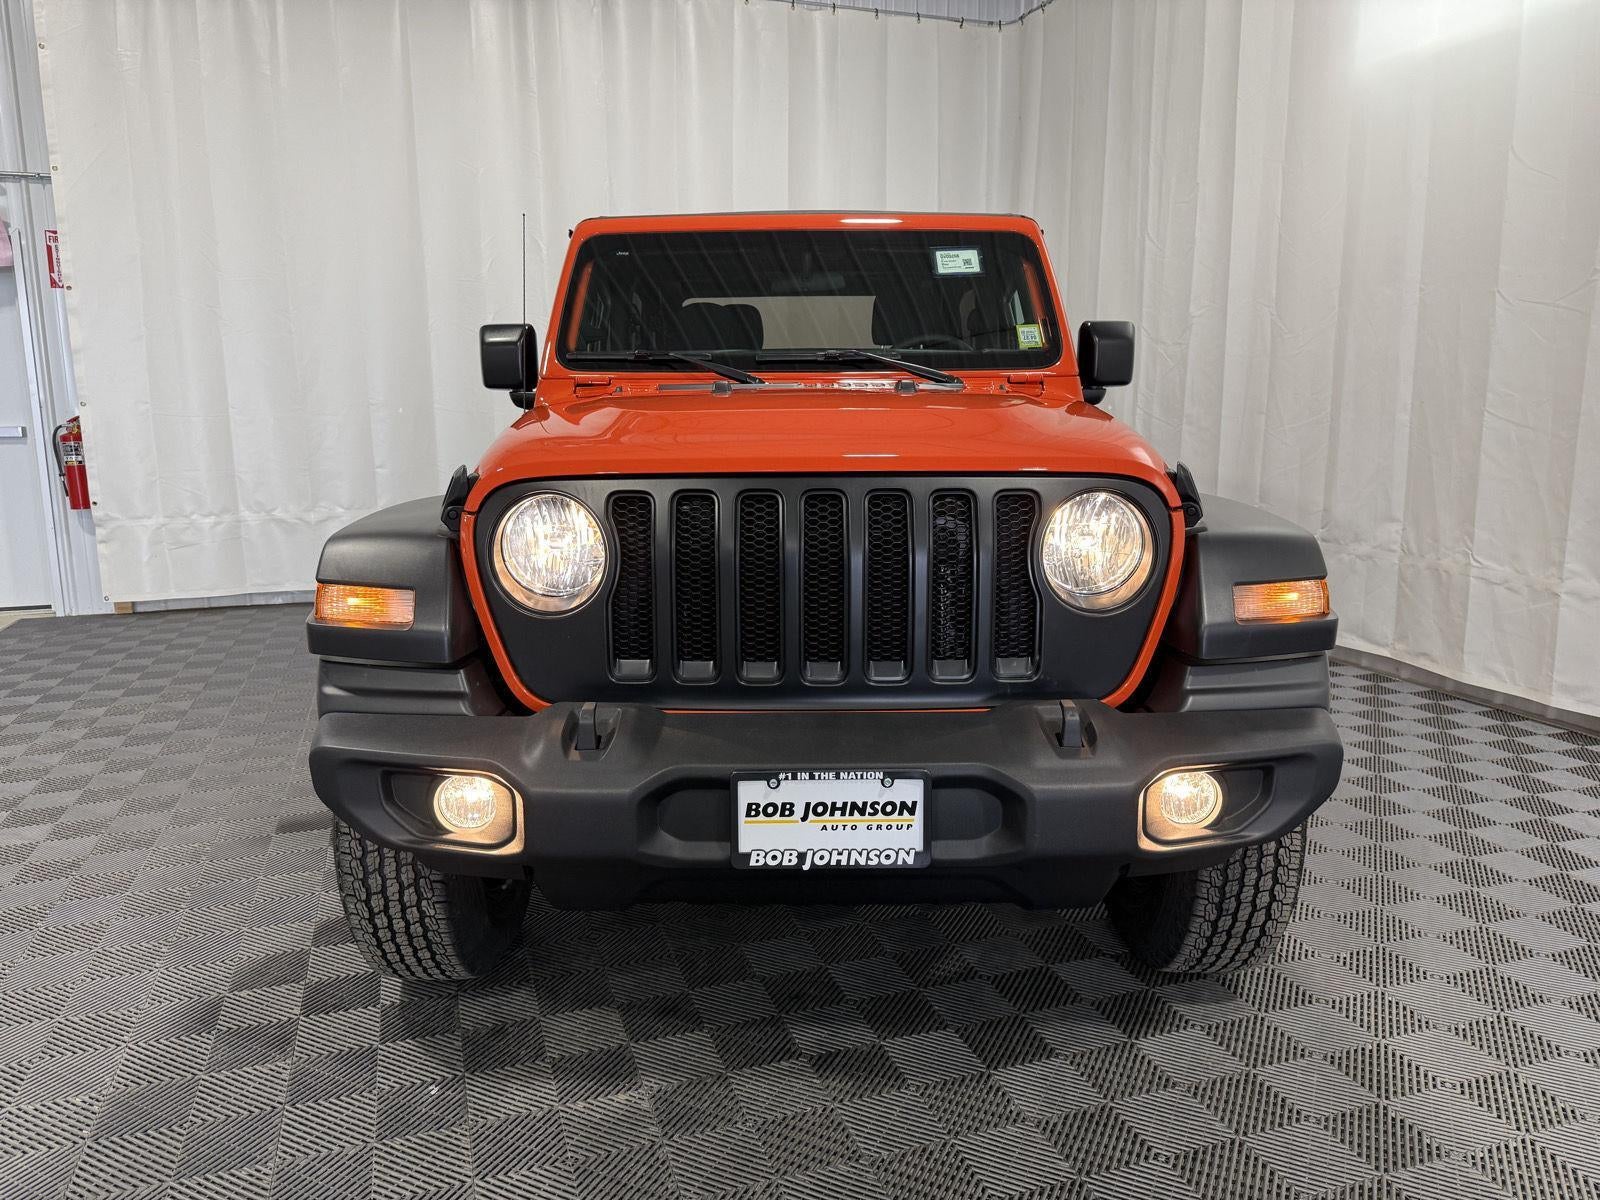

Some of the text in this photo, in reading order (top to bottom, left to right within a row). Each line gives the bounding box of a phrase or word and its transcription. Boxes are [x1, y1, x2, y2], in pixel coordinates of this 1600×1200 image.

[48, 235, 59, 243] FIR
[779, 771, 884, 780] #1 IN THE NATION
[744, 800, 918, 822] BOB JOHNSON
[866, 823, 913, 831] GROUP
[749, 849, 916, 870] BOB JOHNSON
